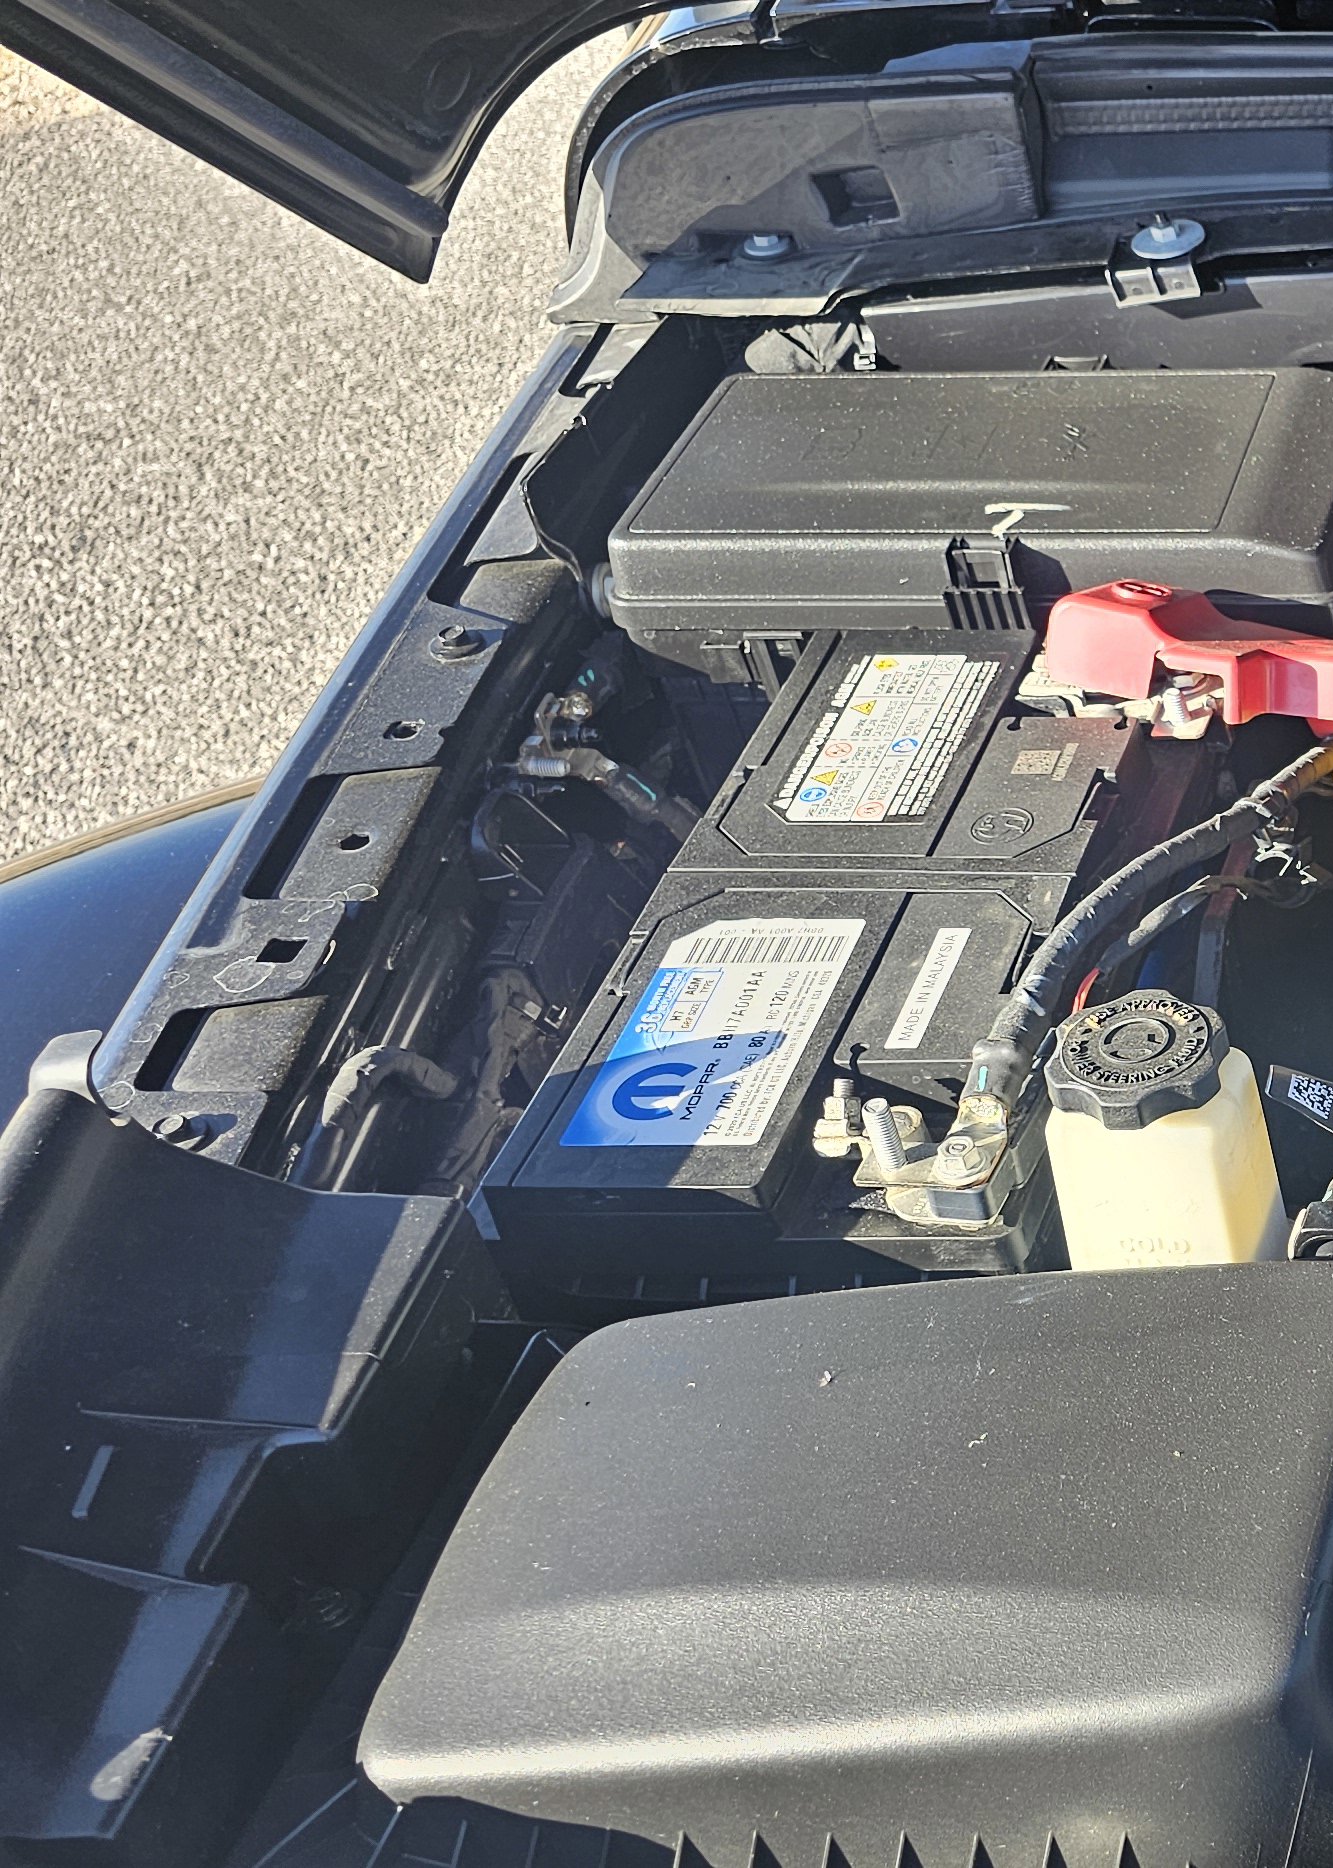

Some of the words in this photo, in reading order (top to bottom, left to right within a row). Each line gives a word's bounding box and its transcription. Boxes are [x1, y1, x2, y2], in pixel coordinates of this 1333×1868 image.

[922, 934, 958, 989] MALAYSIA
[684, 977, 704, 994] AGM
[915, 992, 931, 1003] IN
[632, 1012, 666, 1032] 36
[1119, 999, 1200, 1026] APPROVED
[898, 1008, 924, 1041] MADE
[703, 1124, 721, 1135] 12
[715, 1092, 737, 1110] 700
[747, 1036, 766, 1047] 80
[768, 990, 790, 1006] 120
[1096, 1064, 1171, 1084] STEERING
